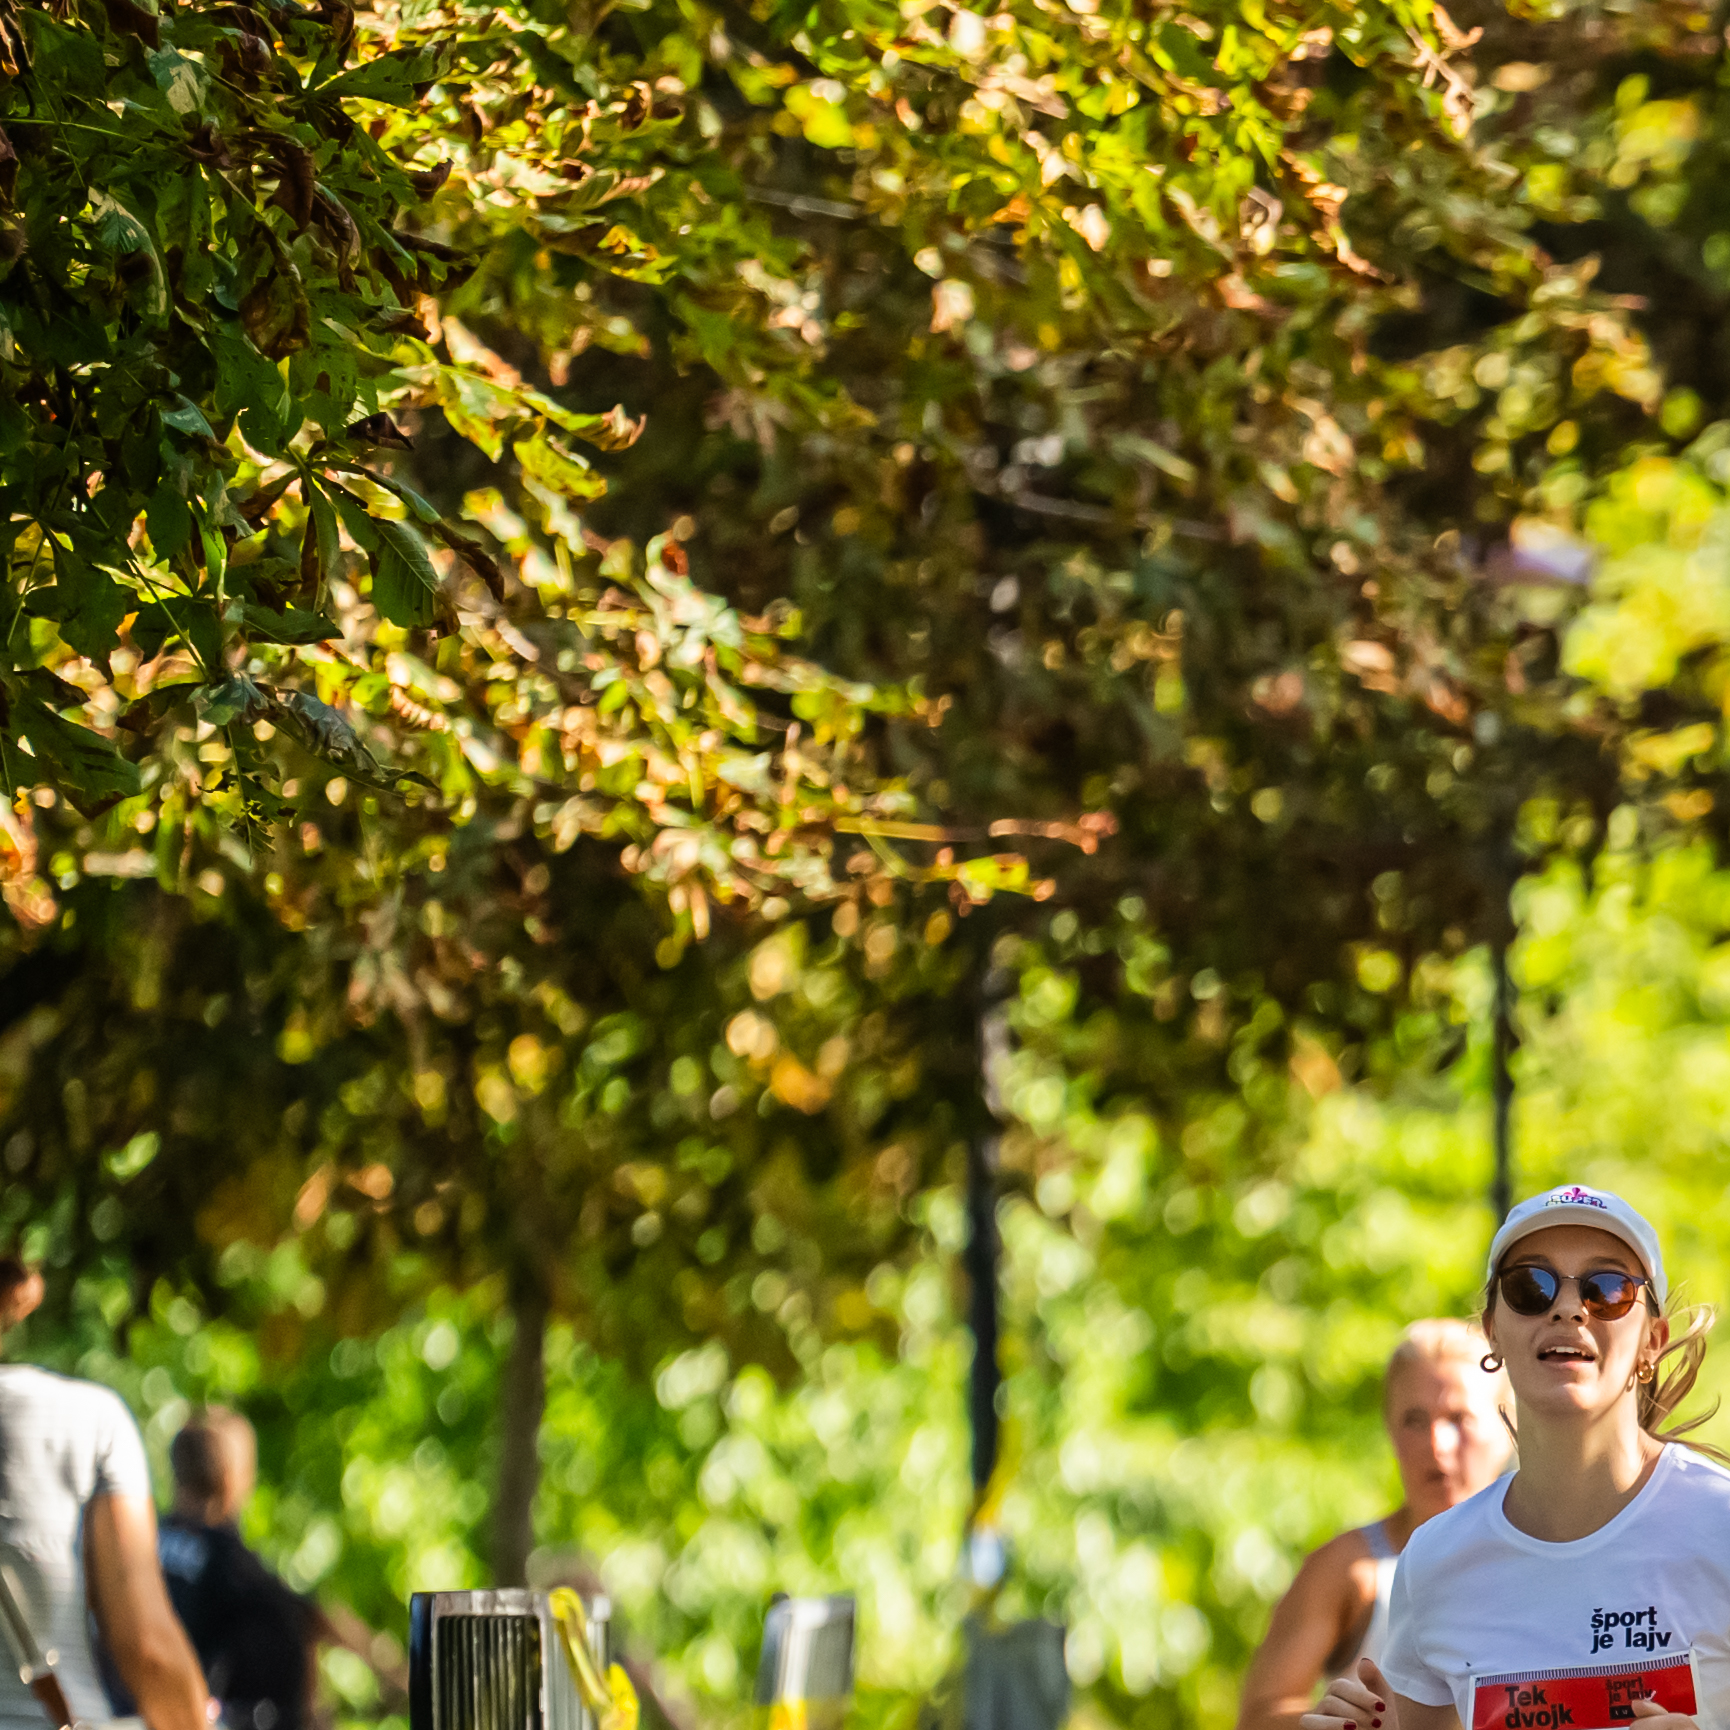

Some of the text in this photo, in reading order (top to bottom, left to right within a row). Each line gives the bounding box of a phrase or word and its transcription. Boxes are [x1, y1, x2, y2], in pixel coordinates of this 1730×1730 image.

[1590, 1606, 1658, 1632] šport
[1590, 1627, 1673, 1654] je lajv
[1505, 1685, 1549, 1707] Tek
[1505, 1702, 1576, 1730] dvojk
